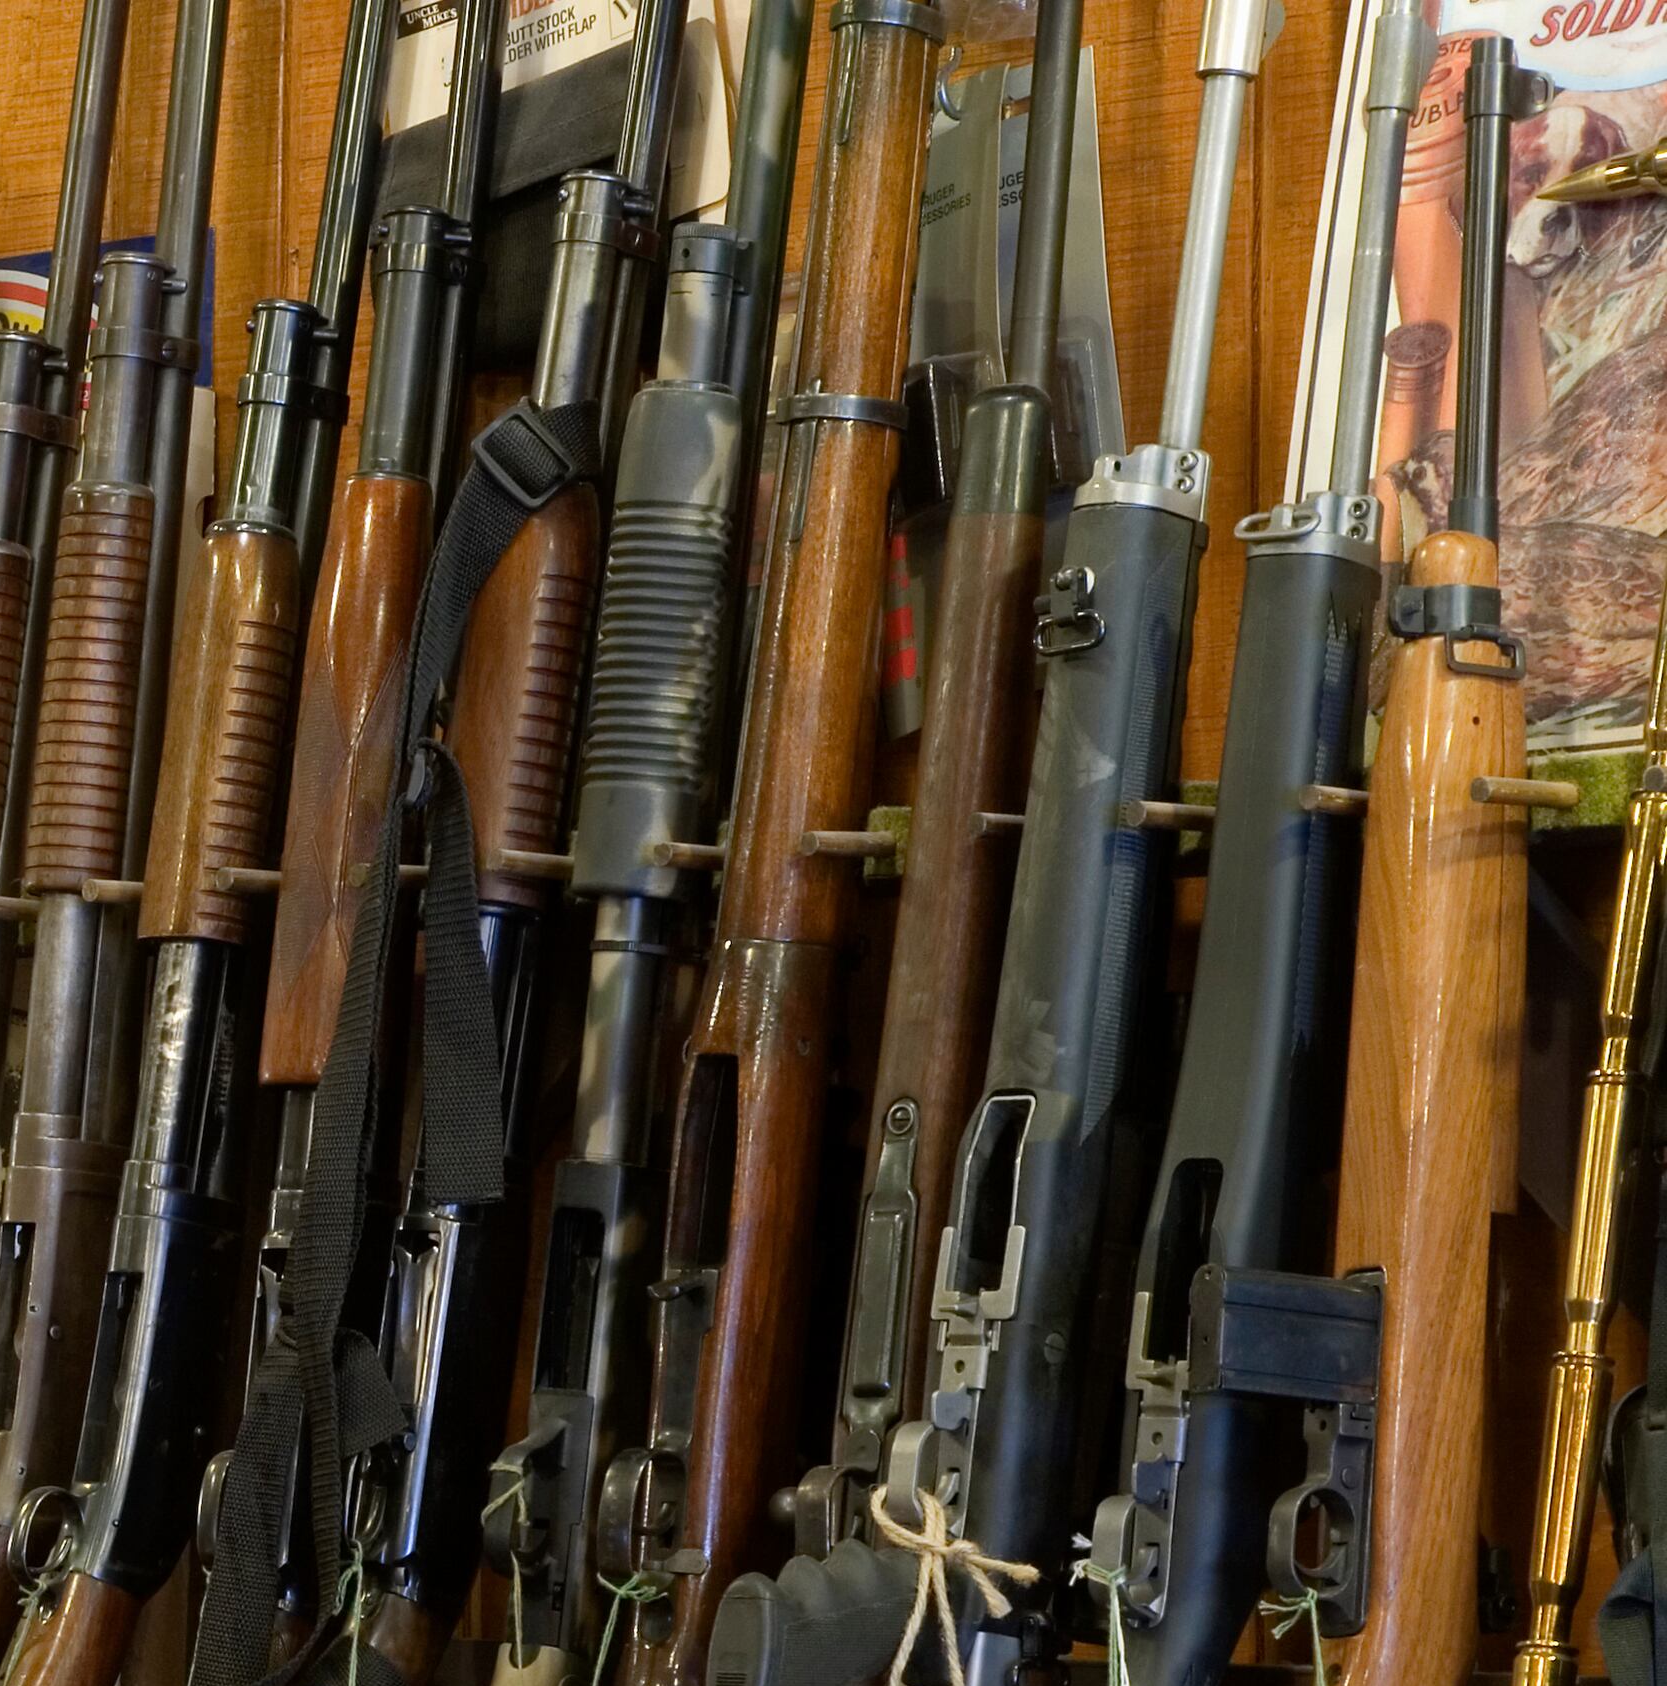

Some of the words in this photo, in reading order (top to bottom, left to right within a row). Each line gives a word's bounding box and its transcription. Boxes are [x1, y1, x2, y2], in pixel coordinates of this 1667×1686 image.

[405, 3, 440, 25] UNCLE
[421, 7, 458, 29] MIKE'S
[537, 6, 576, 34] STOCK
[1530, 0, 1646, 47] SOLD
[534, 31, 566, 57] WITH
[568, 14, 597, 40] FLAP
